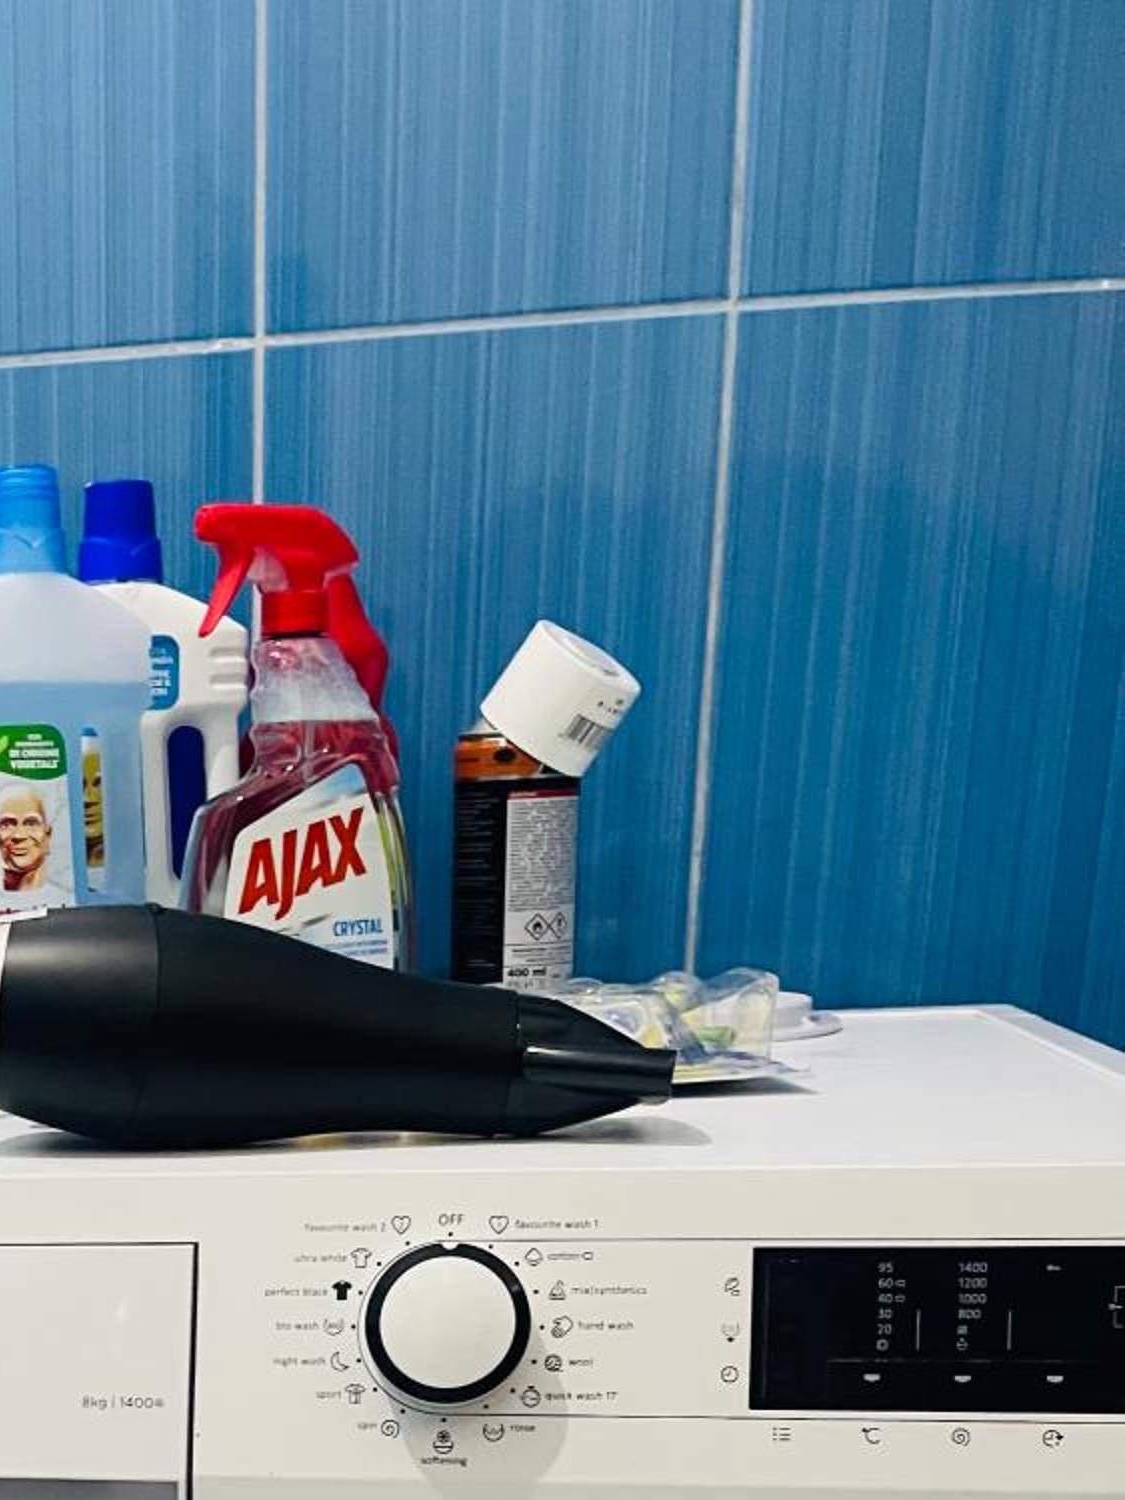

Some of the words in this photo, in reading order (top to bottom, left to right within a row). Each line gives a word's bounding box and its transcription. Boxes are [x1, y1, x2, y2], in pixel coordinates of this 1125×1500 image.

[238, 806, 367, 921] AJAX
[333, 918, 383, 937] CRYSTAL
[507, 968, 530, 977] 400
[438, 1213, 464, 1226] OFF
[565, 1219, 592, 1228] wash
[878, 1261, 894, 1273] 95
[958, 1261, 988, 1273] 1400
[878, 1277, 894, 1289] 60
[958, 1277, 988, 1289] 1200
[608, 1320, 634, 1330] wash
[877, 1323, 892, 1335] 20
[420, 1455, 468, 1467] softening
